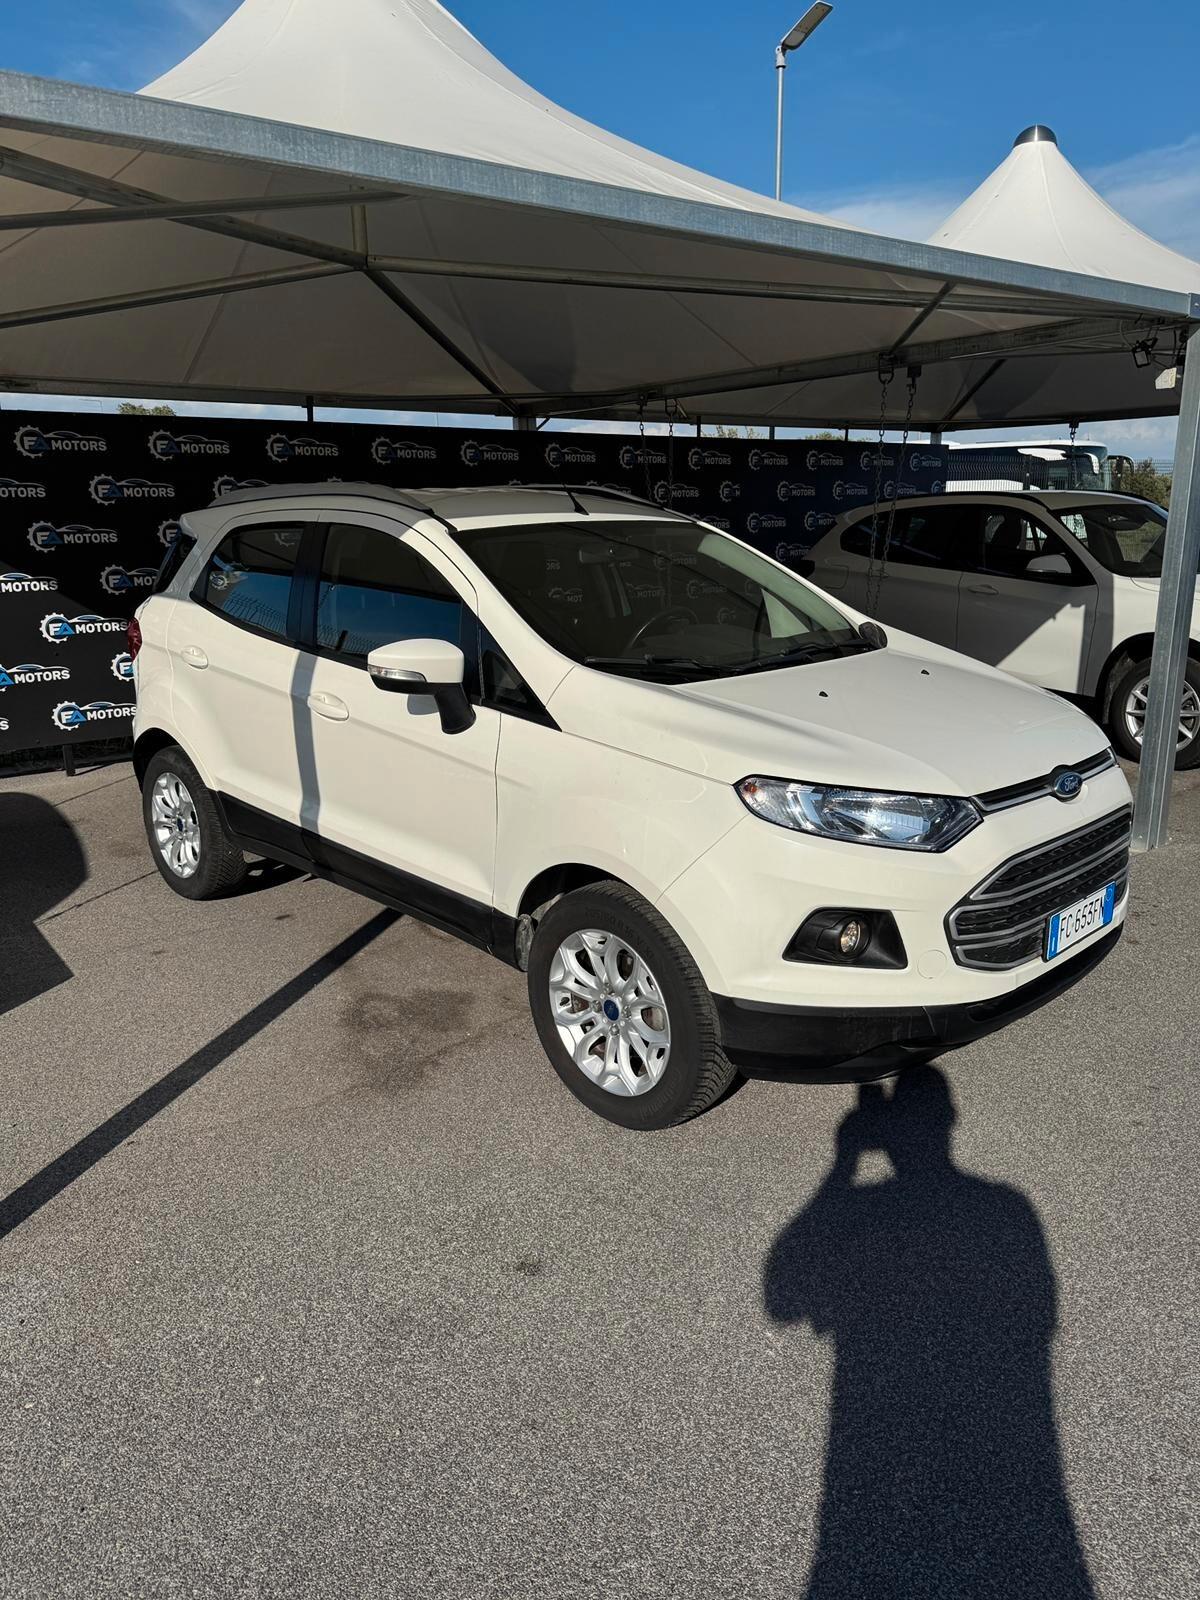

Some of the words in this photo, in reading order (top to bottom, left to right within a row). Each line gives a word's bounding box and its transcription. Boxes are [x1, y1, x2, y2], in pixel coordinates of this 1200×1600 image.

[23, 436, 50, 452] FA
[51, 440, 107, 451] MOTORS
[155, 440, 180, 454] FA
[181, 443, 230, 454] MOTORS
[295, 446, 339, 456] MOTORS
[397, 449, 437, 460] MOTORS
[483, 451, 519, 461] MOTORS
[565, 454, 596, 463] MOTORS
[705, 457, 732, 465] MOTORS
[763, 458, 789, 466] MOTORS
[0, 486, 47, 498] OTORS
[97, 484, 123, 498] FA
[124, 487, 176, 498] MOTORS
[671, 489, 700, 498] MOTORS
[792, 489, 816, 497] MOTORS
[36, 531, 64, 545] FA
[63, 533, 119, 544] MOTORS
[1, 580, 58, 592] MOTORS
[48, 622, 76, 637] FA
[75, 622, 128, 634] MOTORS
[14, 669, 71, 684] MOTORS
[60, 710, 88, 725] FA
[86, 707, 136, 721] MOTORS
[1064, 775, 1080, 792] Ford
